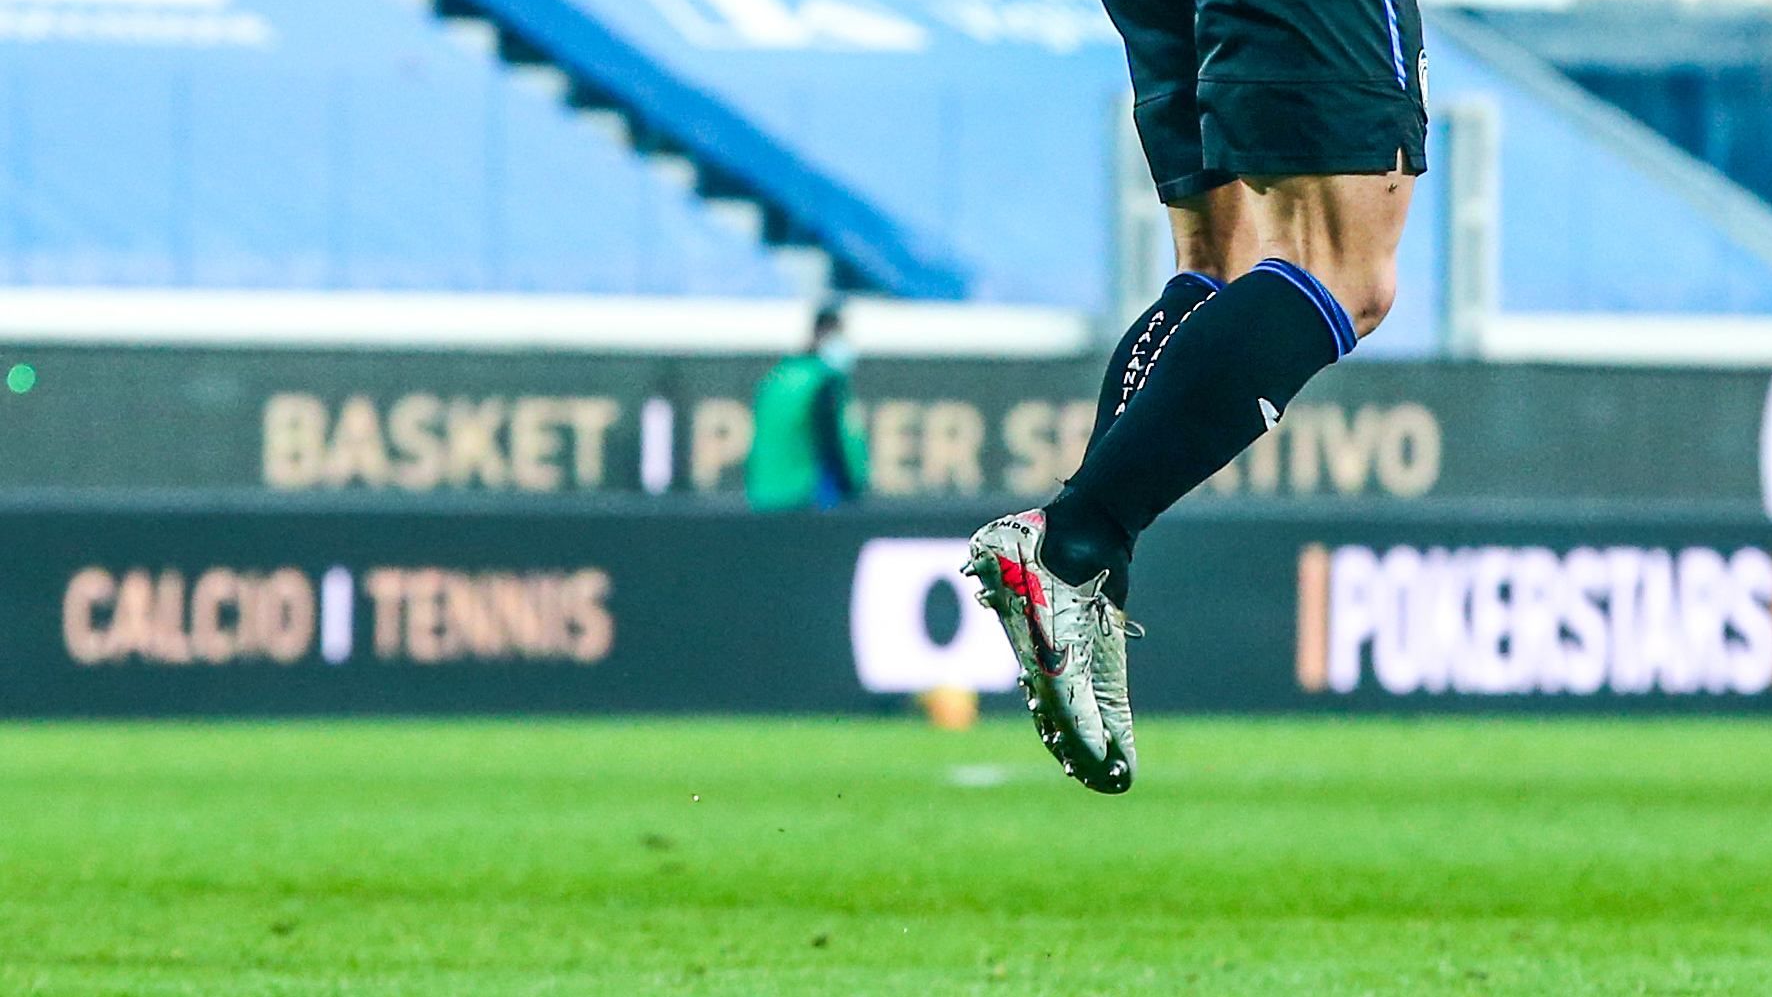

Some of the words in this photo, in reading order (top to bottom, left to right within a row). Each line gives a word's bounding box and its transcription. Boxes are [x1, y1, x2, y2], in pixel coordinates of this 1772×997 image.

[1113, 310, 1165, 417] ATALANTA
[262, 393, 620, 492] BASKET
[690, 398, 986, 494] PER
[63, 566, 314, 664] CALCIO
[366, 567, 614, 664] TENNIS
